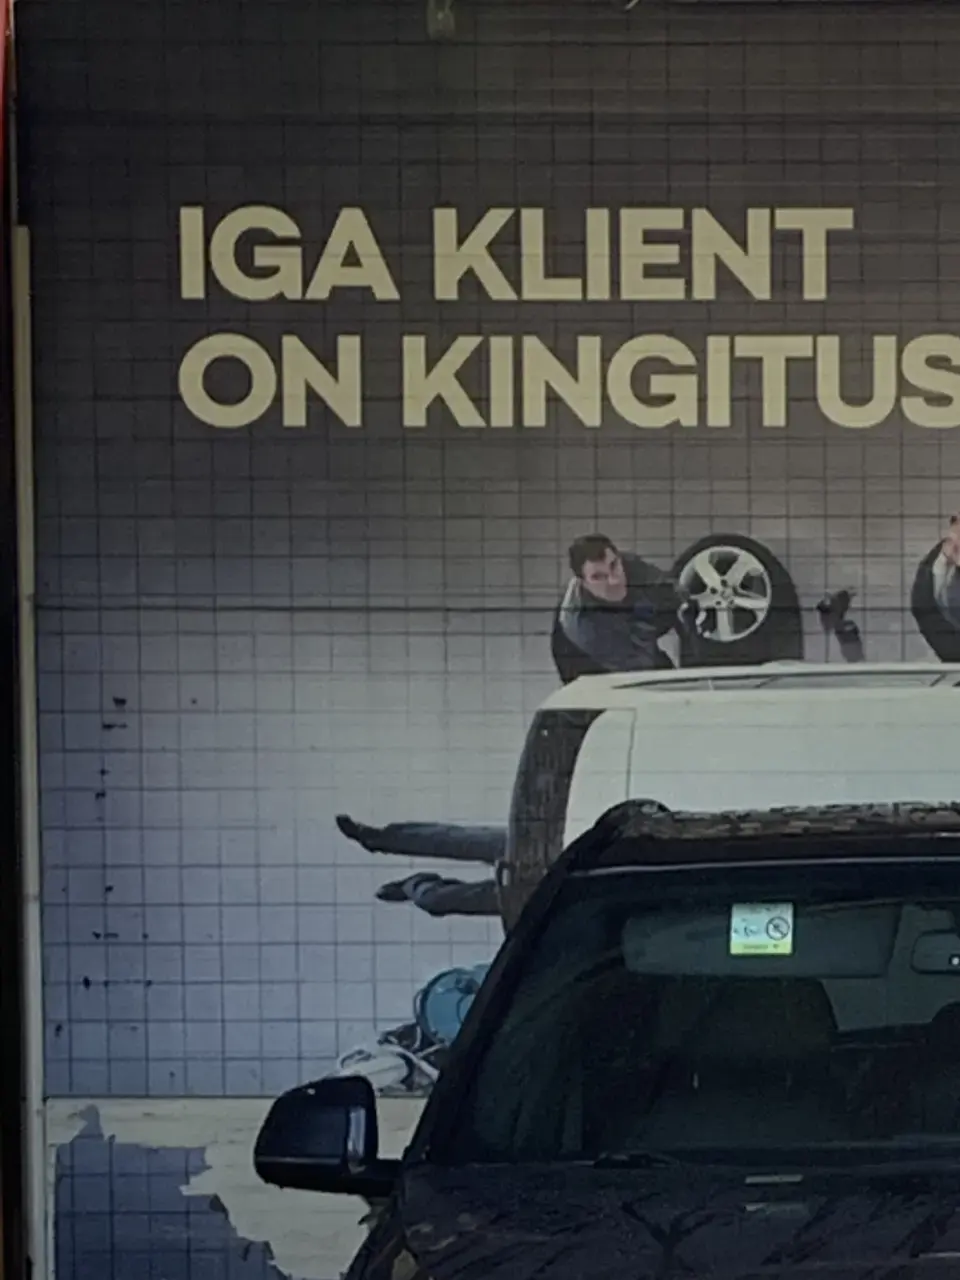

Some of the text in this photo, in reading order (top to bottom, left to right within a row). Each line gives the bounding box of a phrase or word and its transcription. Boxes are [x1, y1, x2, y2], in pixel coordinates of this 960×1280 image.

[180, 206, 854, 301] IGA KLIENT
[178, 333, 362, 429] ON
